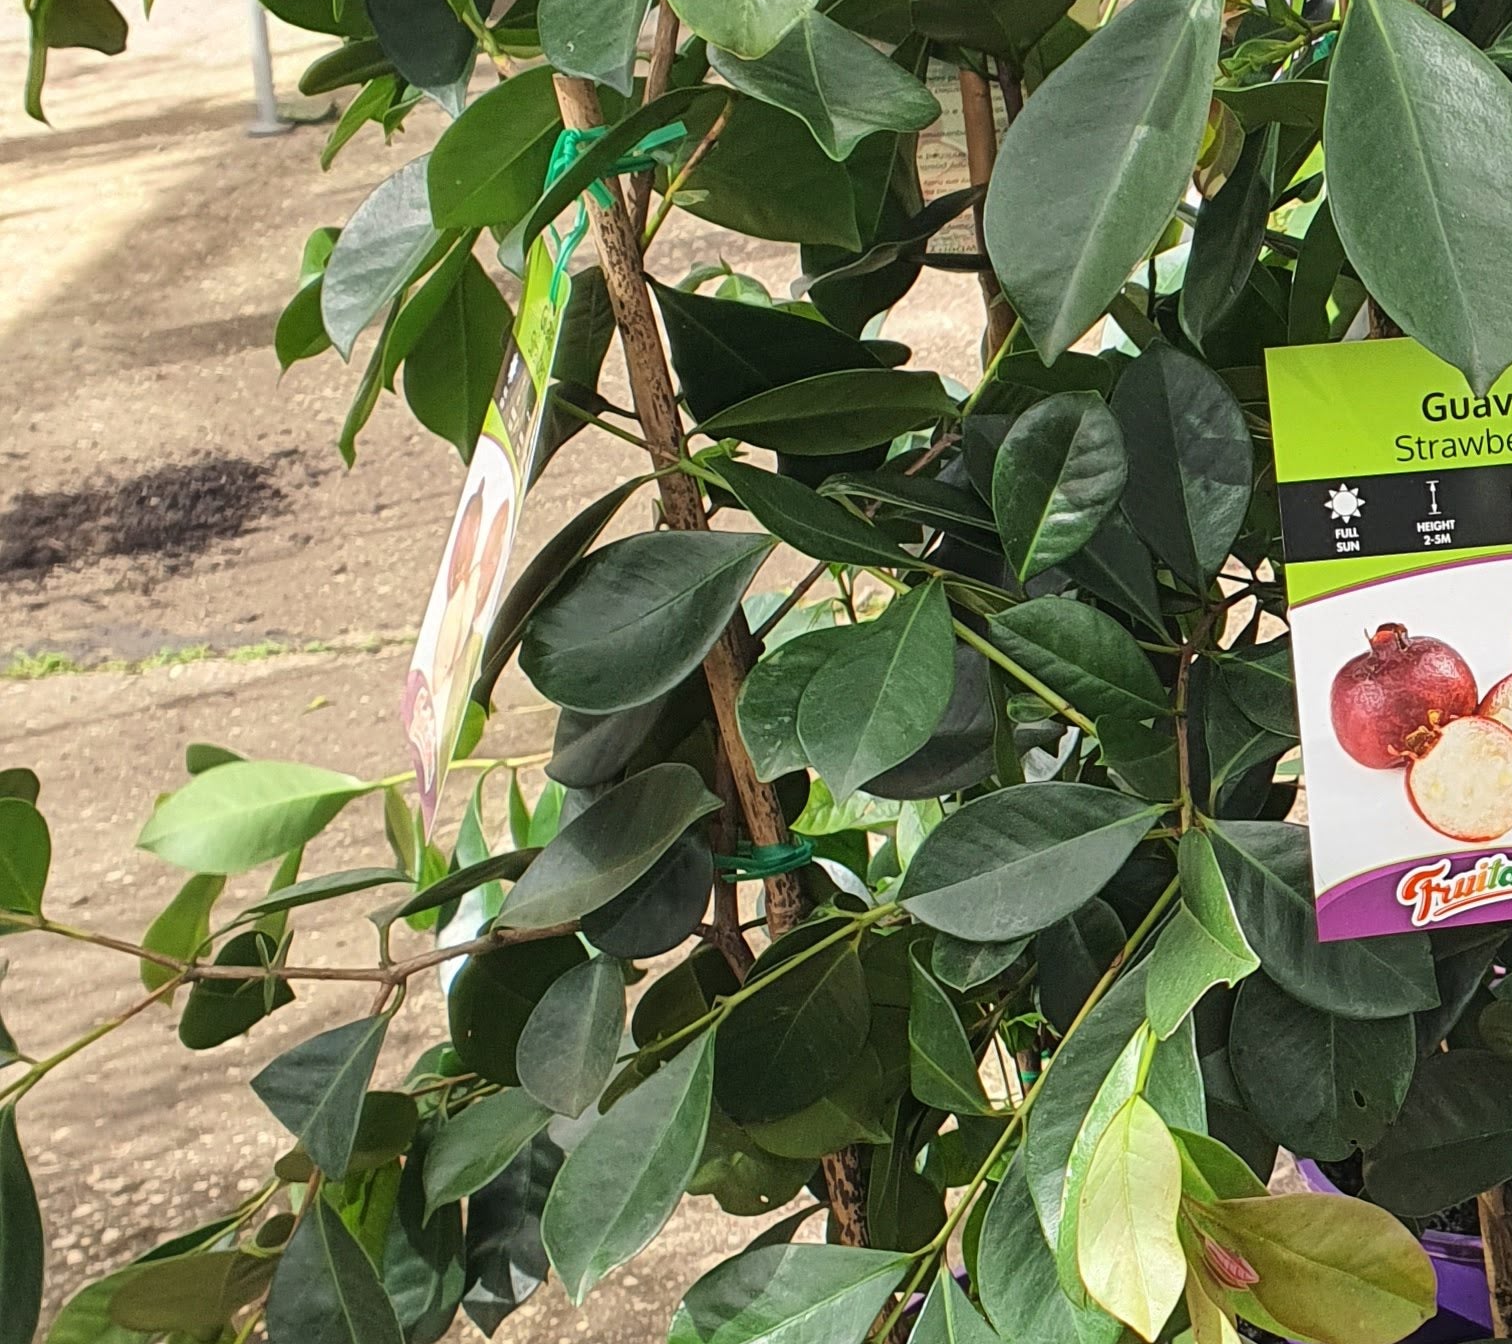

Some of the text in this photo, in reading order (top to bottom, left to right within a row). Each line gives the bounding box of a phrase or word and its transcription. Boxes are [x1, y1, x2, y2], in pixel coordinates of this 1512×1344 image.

[1334, 526, 1360, 540] FULL
[1416, 519, 1456, 533] HEIGHT
[1423, 532, 1452, 546] 2-5M
[1335, 540, 1361, 553] SUN
